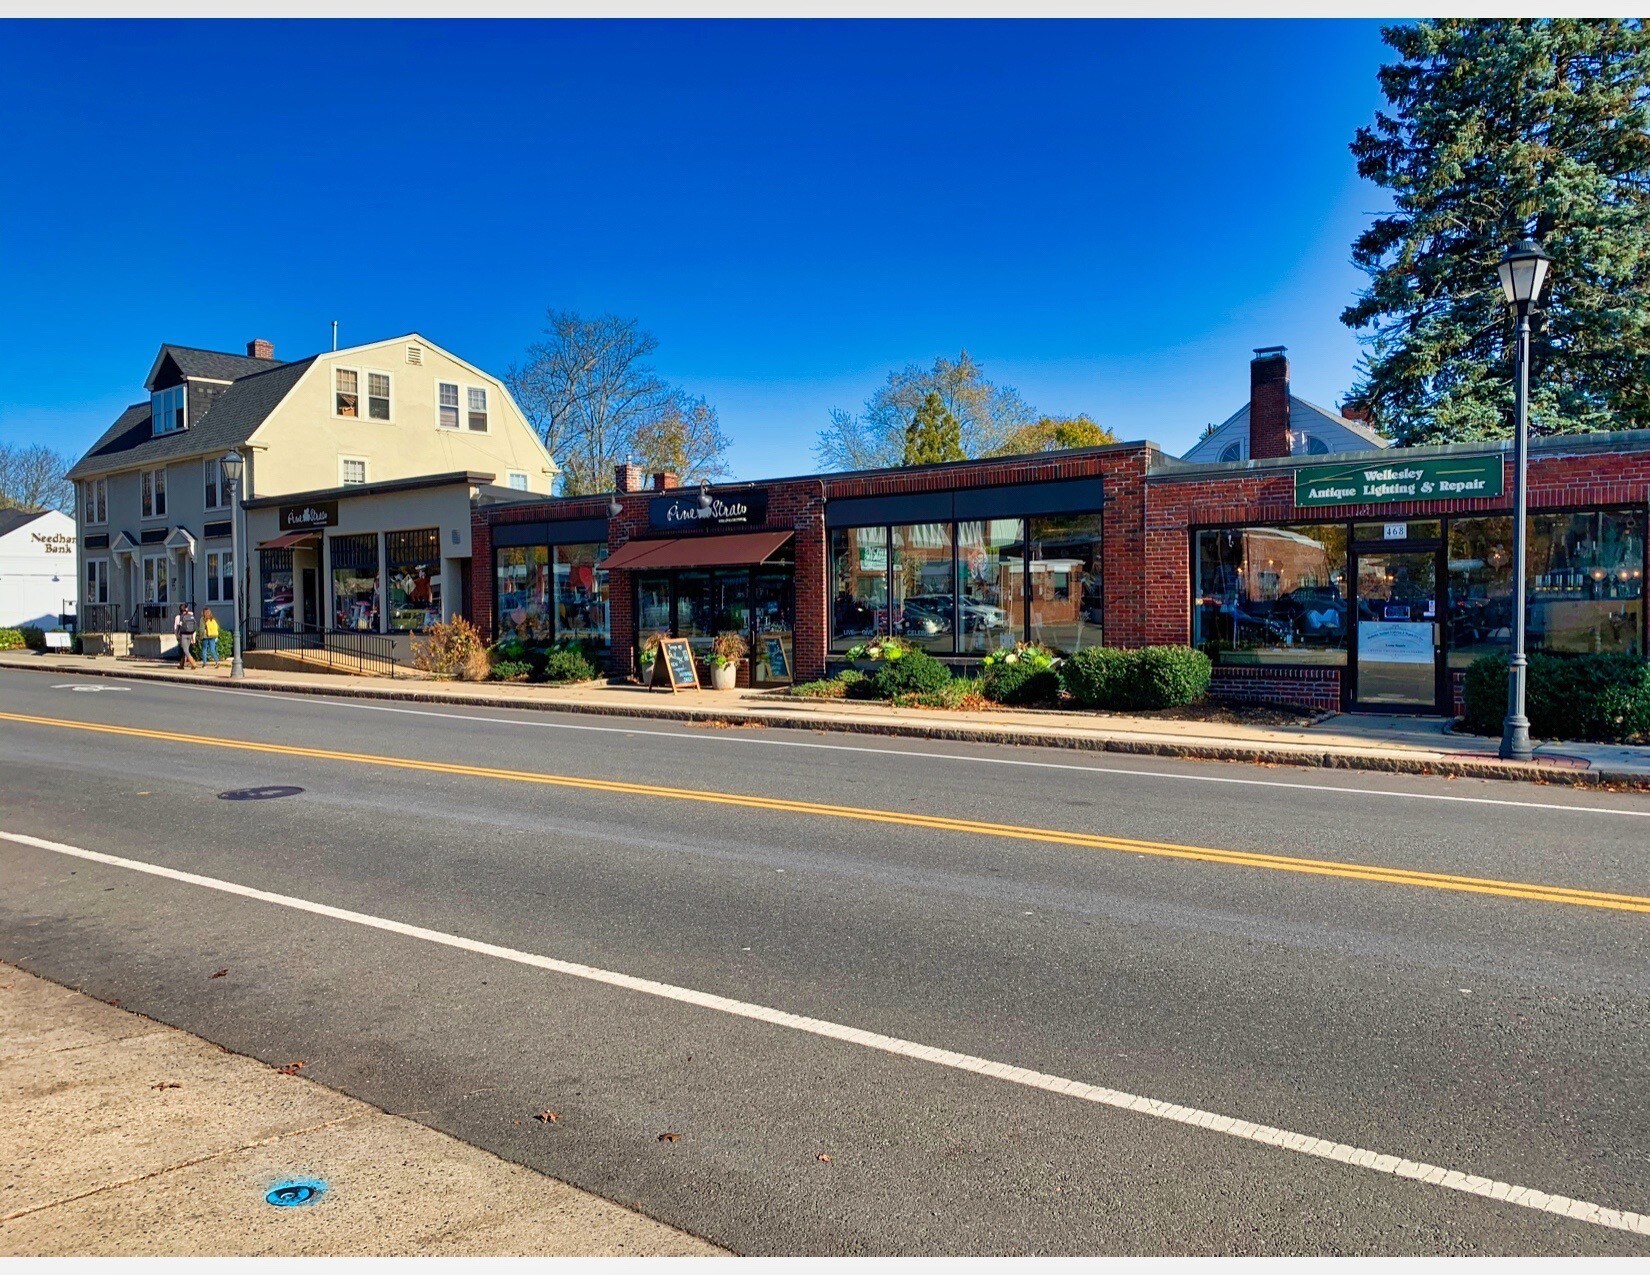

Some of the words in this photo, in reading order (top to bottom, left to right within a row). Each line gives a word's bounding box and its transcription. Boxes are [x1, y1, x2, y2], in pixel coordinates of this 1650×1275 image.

[1364, 468, 1424, 481] Wellesley
[1308, 487, 1357, 499] Antique
[1363, 482, 1415, 496] Lighting
[1420, 480, 1435, 494] &
[1439, 479, 1485, 492] Repair
[667, 500, 698, 522] Pine
[712, 499, 747, 518] Straw
[1386, 526, 1404, 536] 468
[45, 543, 72, 554] Bank
